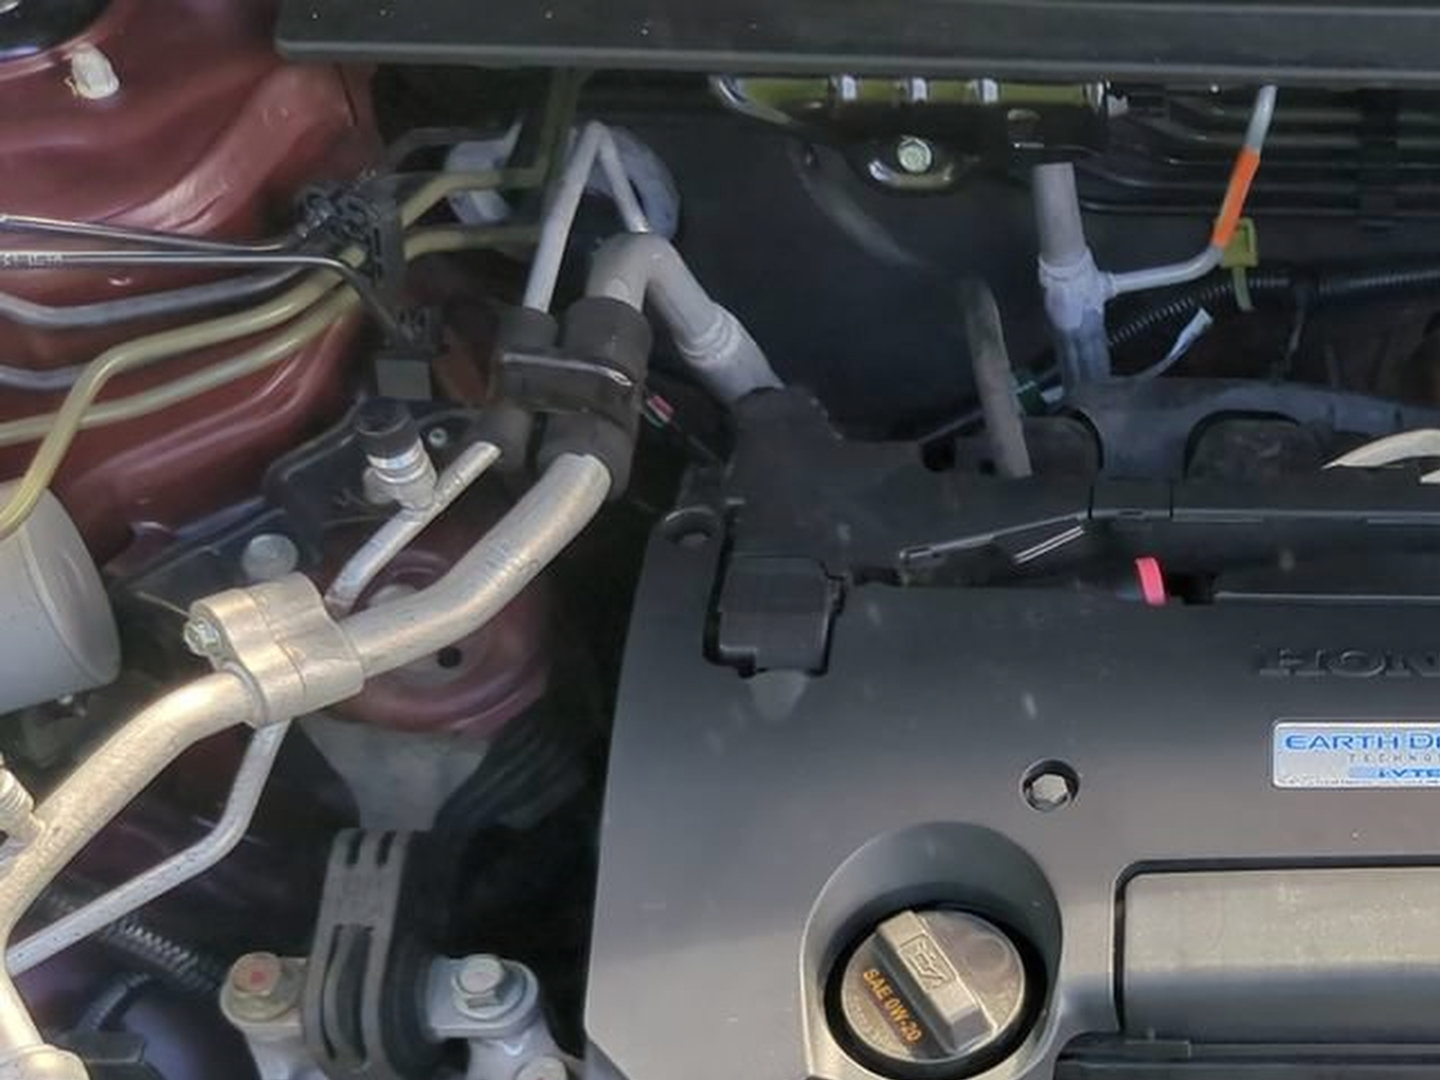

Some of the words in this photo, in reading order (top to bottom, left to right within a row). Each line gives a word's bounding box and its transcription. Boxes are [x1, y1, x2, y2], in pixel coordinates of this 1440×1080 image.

[1284, 733, 1399, 750] EARTH
[862, 968, 893, 1000] SAE
[885, 997, 922, 1042] 0W-20
